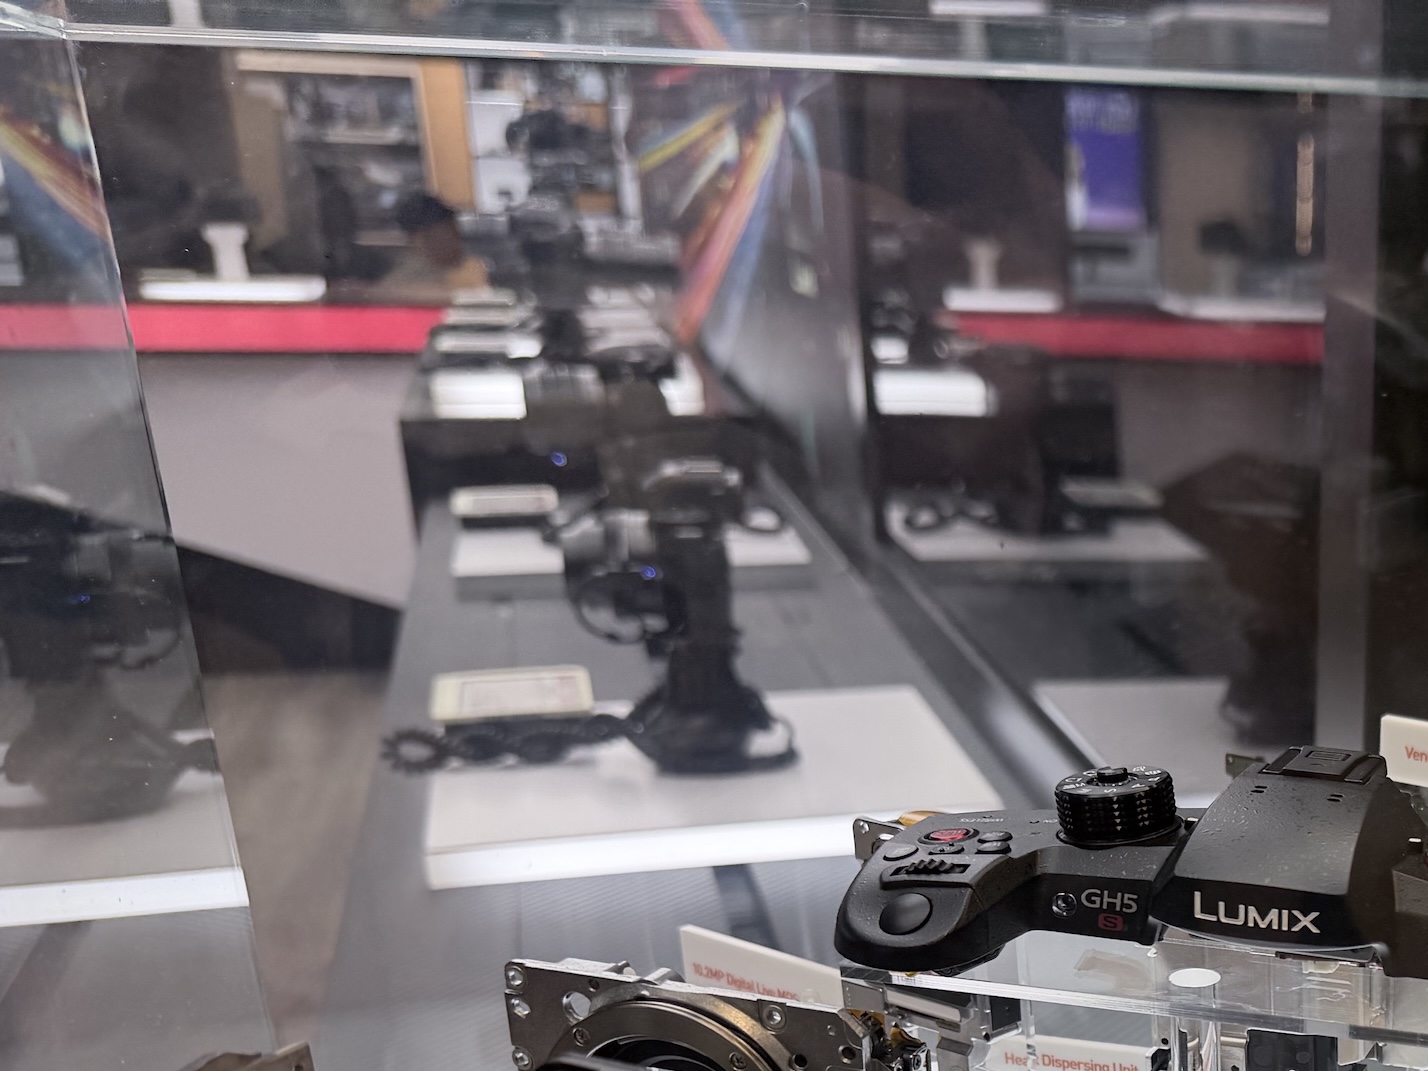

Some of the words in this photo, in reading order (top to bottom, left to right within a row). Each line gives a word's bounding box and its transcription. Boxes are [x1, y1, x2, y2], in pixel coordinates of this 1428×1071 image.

[1081, 888, 1138, 913] GH5
[1194, 891, 1321, 933] LUMIX
[726, 973, 756, 992] Digital
